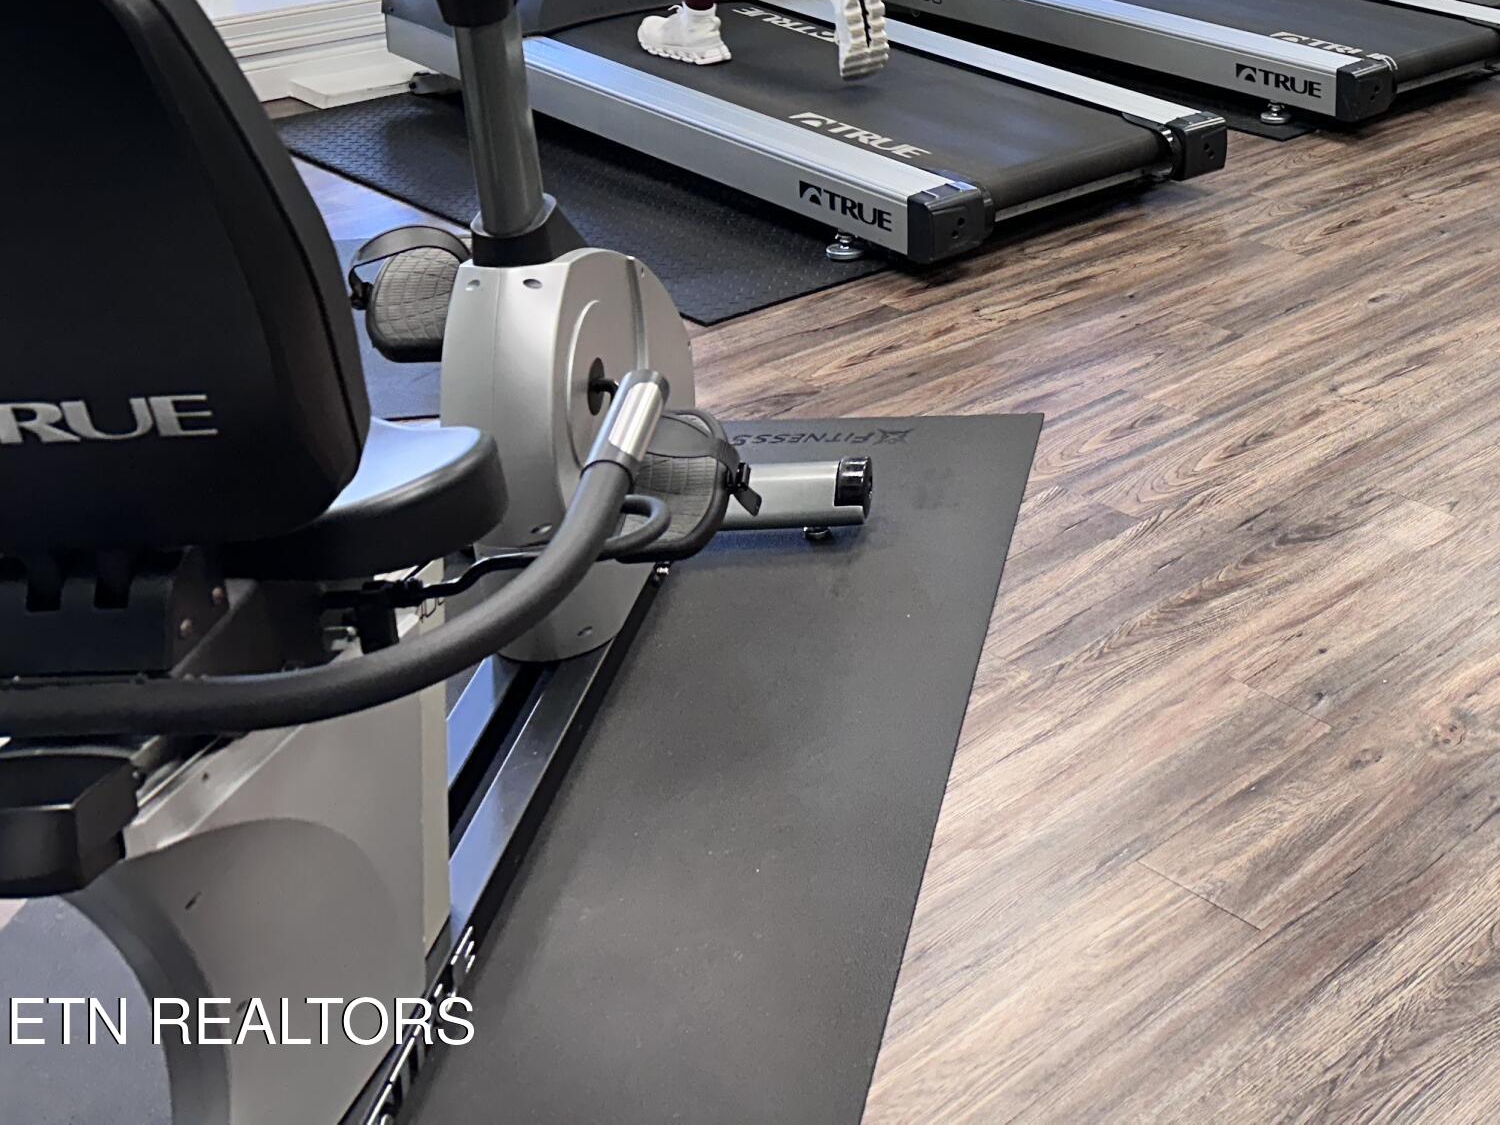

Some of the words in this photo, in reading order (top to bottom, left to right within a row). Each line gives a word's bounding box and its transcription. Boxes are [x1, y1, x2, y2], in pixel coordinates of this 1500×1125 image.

[1258, 69, 1322, 98] TRUE
[828, 122, 932, 159] TRUE
[823, 189, 893, 232] TRUE
